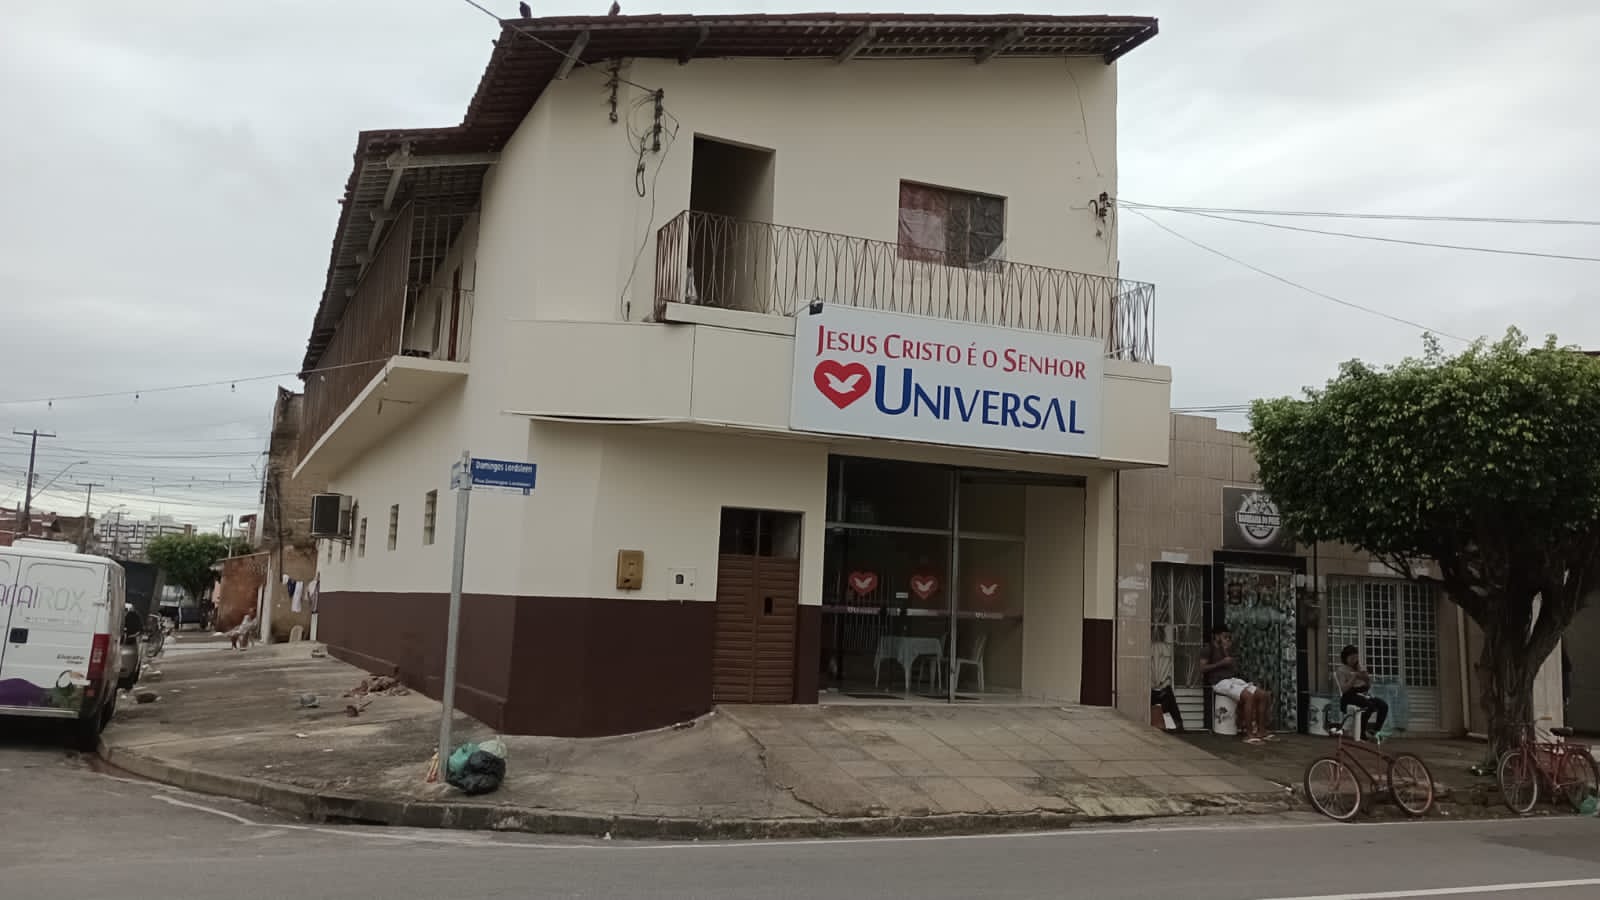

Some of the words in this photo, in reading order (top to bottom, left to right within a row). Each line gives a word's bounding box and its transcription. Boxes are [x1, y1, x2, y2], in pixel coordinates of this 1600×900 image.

[816, 325, 877, 356] JESUS
[883, 334, 961, 364] CRISTO
[967, 342, 977, 366] É
[982, 350, 998, 368] O
[1003, 348, 1087, 380] SENHOR
[875, 364, 1085, 434] UNIVERSAL
